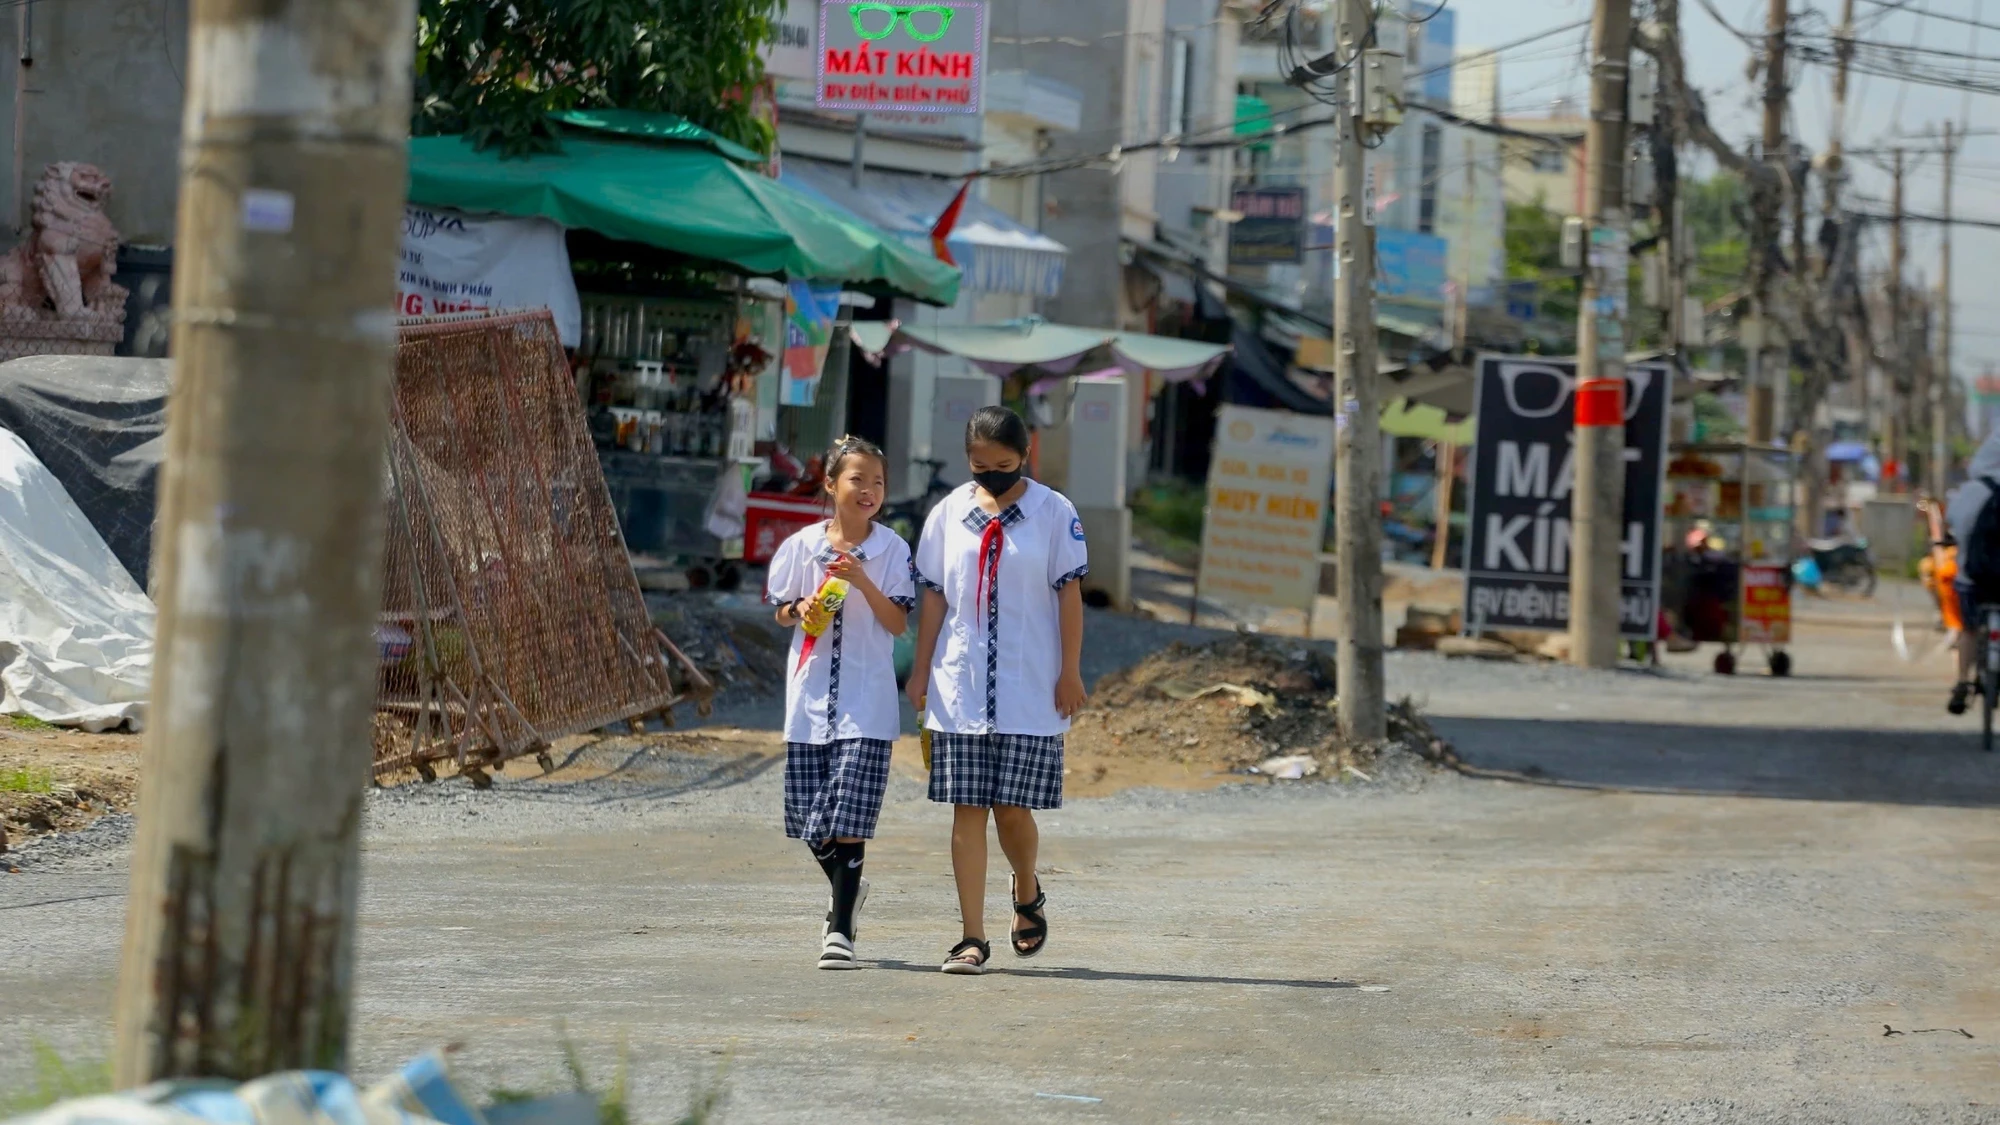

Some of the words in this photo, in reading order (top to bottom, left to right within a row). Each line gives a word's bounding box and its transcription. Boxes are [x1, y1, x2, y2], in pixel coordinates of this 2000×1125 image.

[826, 41, 889, 75] MẮT
[896, 45, 973, 78] KÍNH
[826, 83, 847, 99] BV
[824, 594, 843, 612] C2
